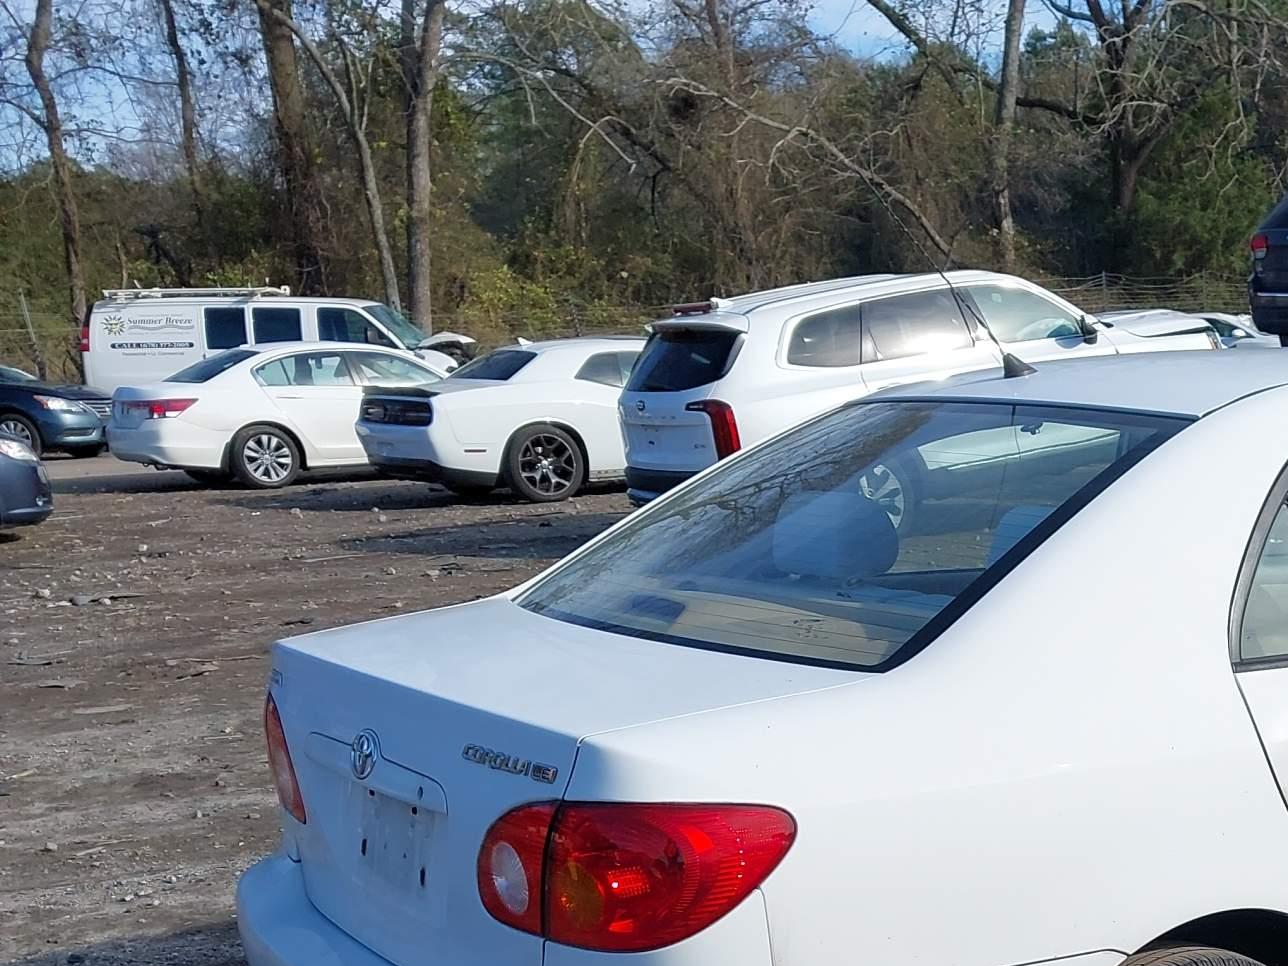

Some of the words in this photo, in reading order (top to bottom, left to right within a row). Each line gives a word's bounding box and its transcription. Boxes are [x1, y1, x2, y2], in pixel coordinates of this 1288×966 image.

[127, 317, 164, 325] Summer
[166, 317, 193, 325] Breeze
[463, 743, 532, 776] COROLLA
